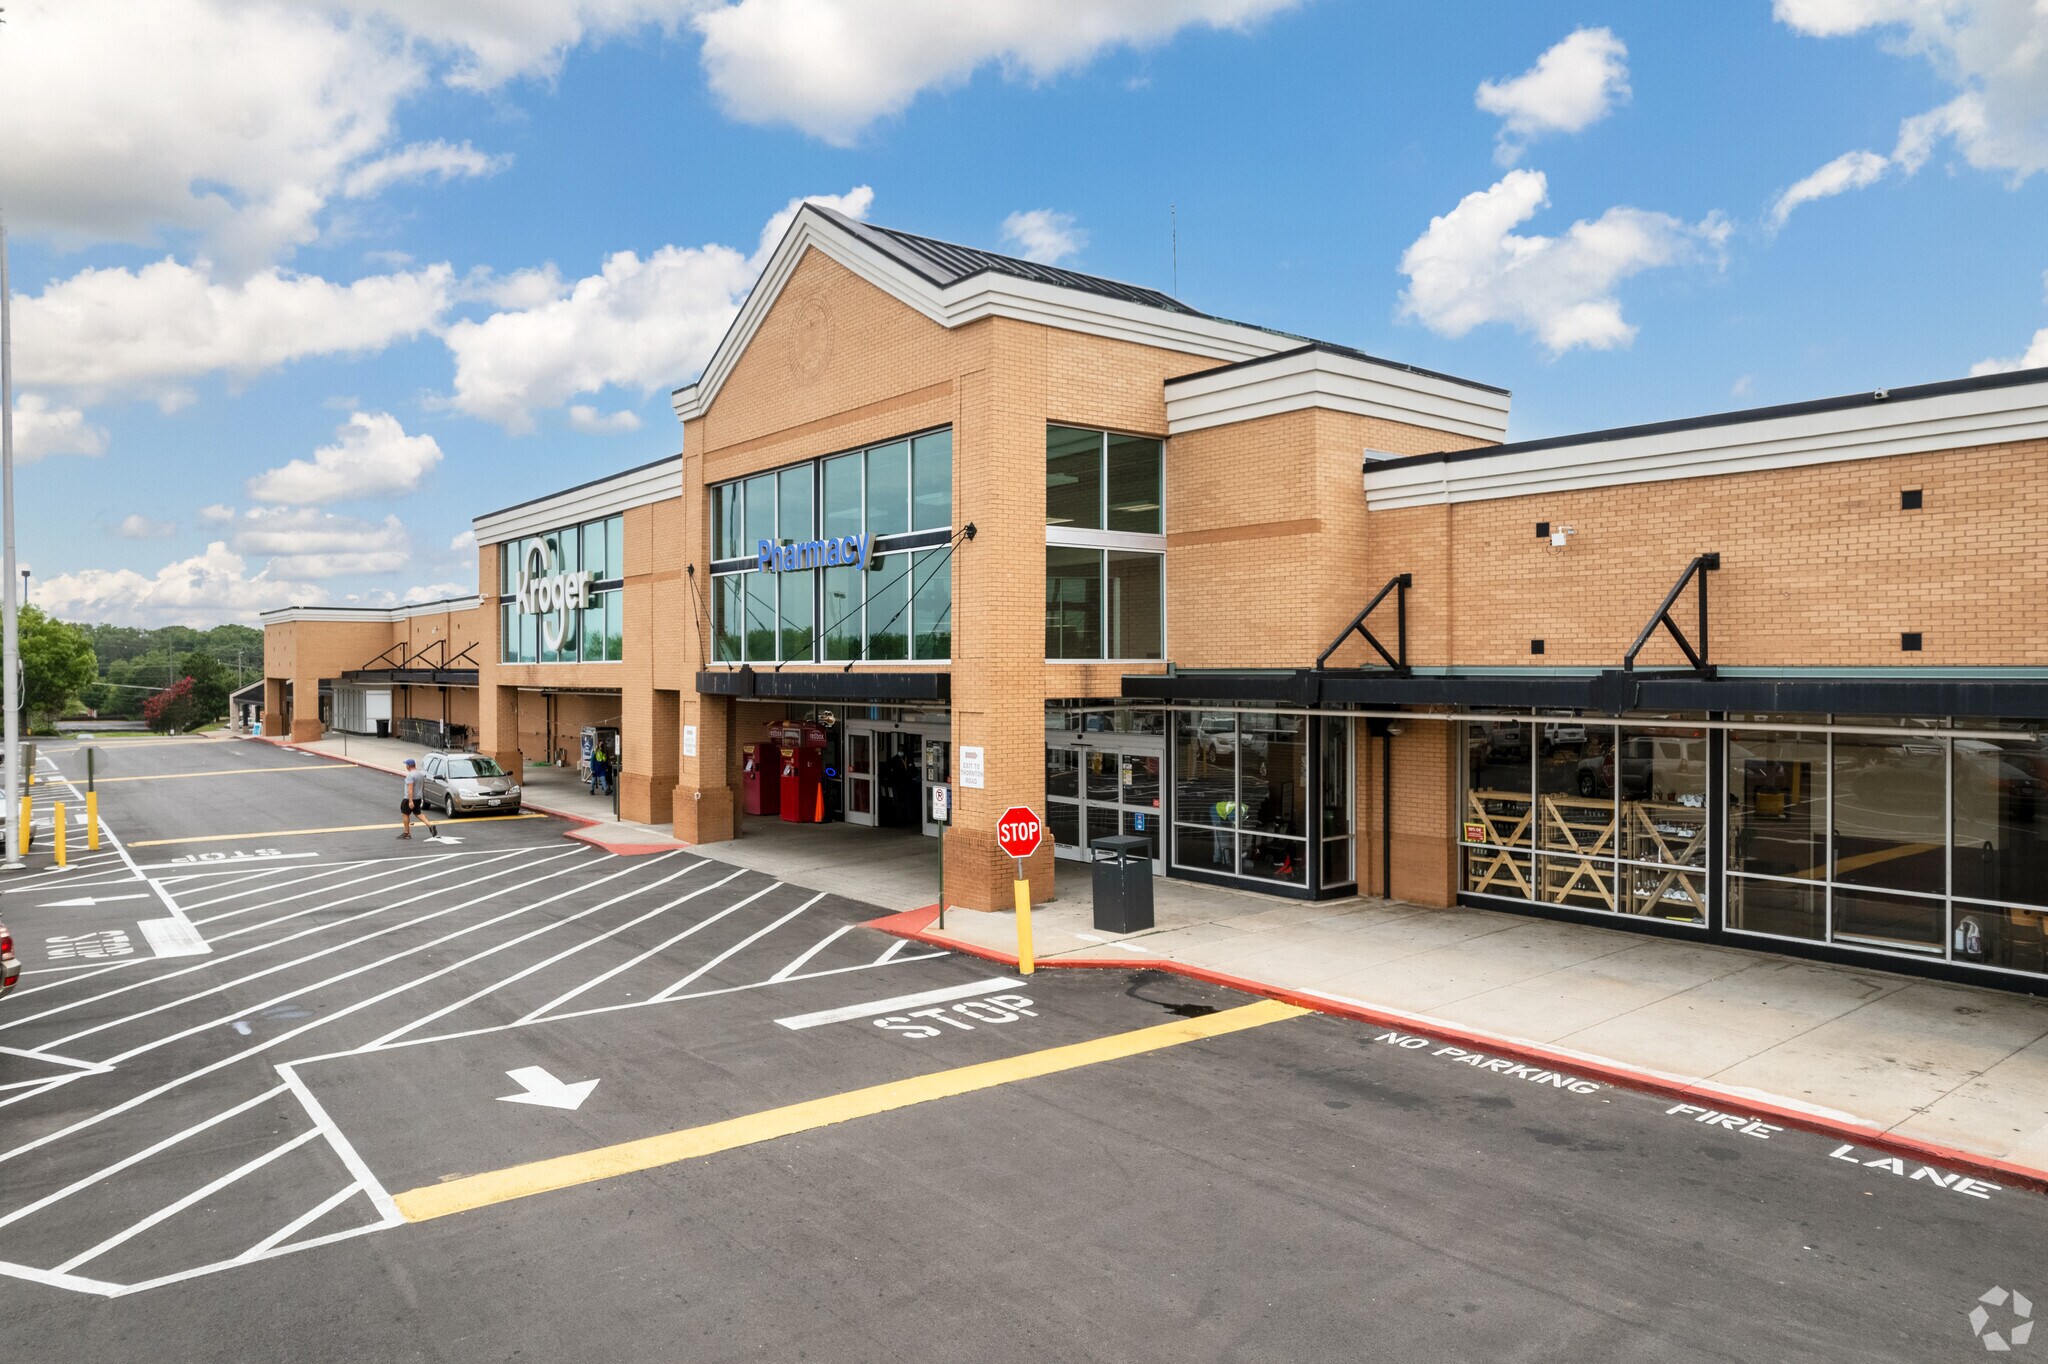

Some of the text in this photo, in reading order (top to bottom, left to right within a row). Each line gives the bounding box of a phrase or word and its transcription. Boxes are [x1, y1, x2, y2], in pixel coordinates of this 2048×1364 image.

[758, 533, 876, 573] Pharmacy
[516, 537, 593, 651] Kroger
[963, 762, 973, 770] EXIT
[1001, 822, 1038, 842] STOP
[171, 848, 281, 863] STOP
[873, 995, 1039, 1038] STOP
[1374, 1032, 1600, 1094] NO PARKING
[1665, 1104, 1783, 1139] FIRE
[1829, 1145, 2002, 1200] LANE
